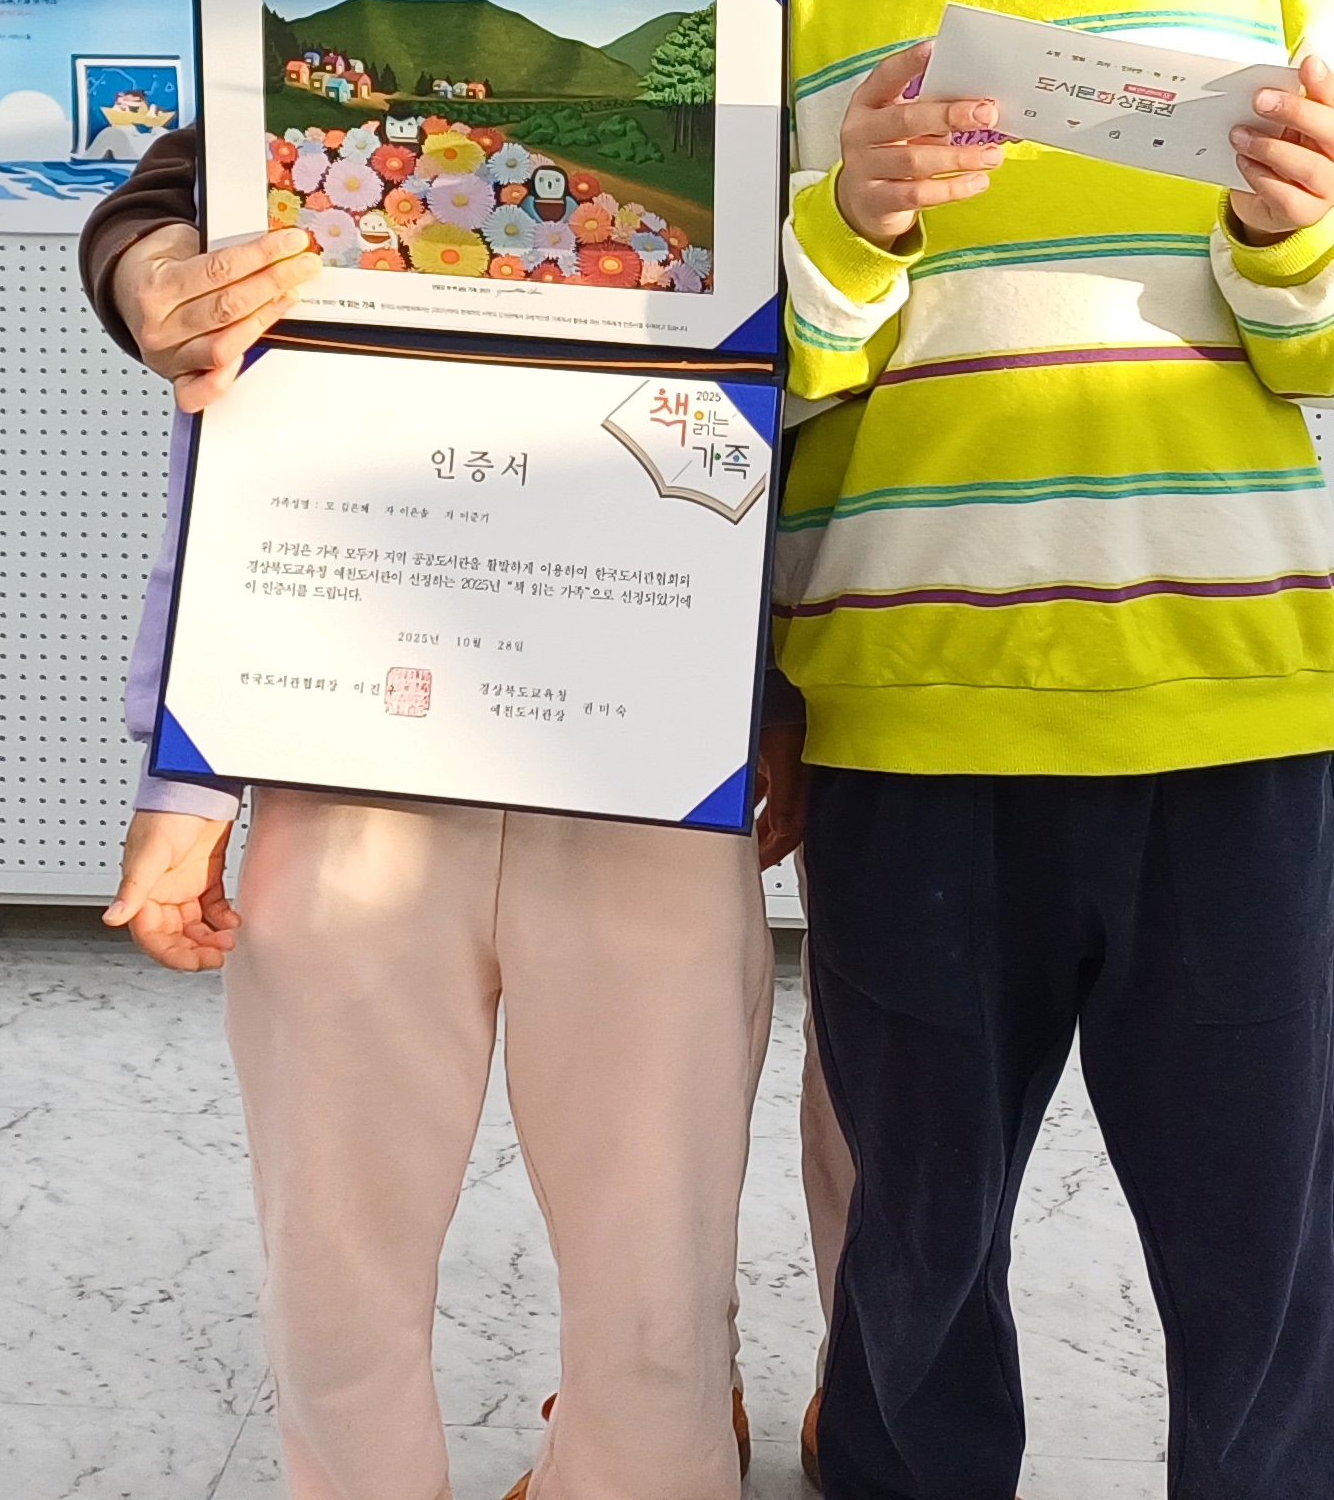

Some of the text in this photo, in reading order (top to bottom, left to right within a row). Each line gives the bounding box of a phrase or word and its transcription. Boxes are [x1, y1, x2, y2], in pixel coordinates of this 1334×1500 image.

[1035, 77, 1177, 117] 도서문화상품권
[696, 391, 721, 403] 2025
[649, 388, 689, 448] 책
[692, 410, 730, 439] 읽는
[430, 446, 529, 487] 인증서
[691, 443, 751, 480] 가족
[398, 631, 440, 646] 2025년
